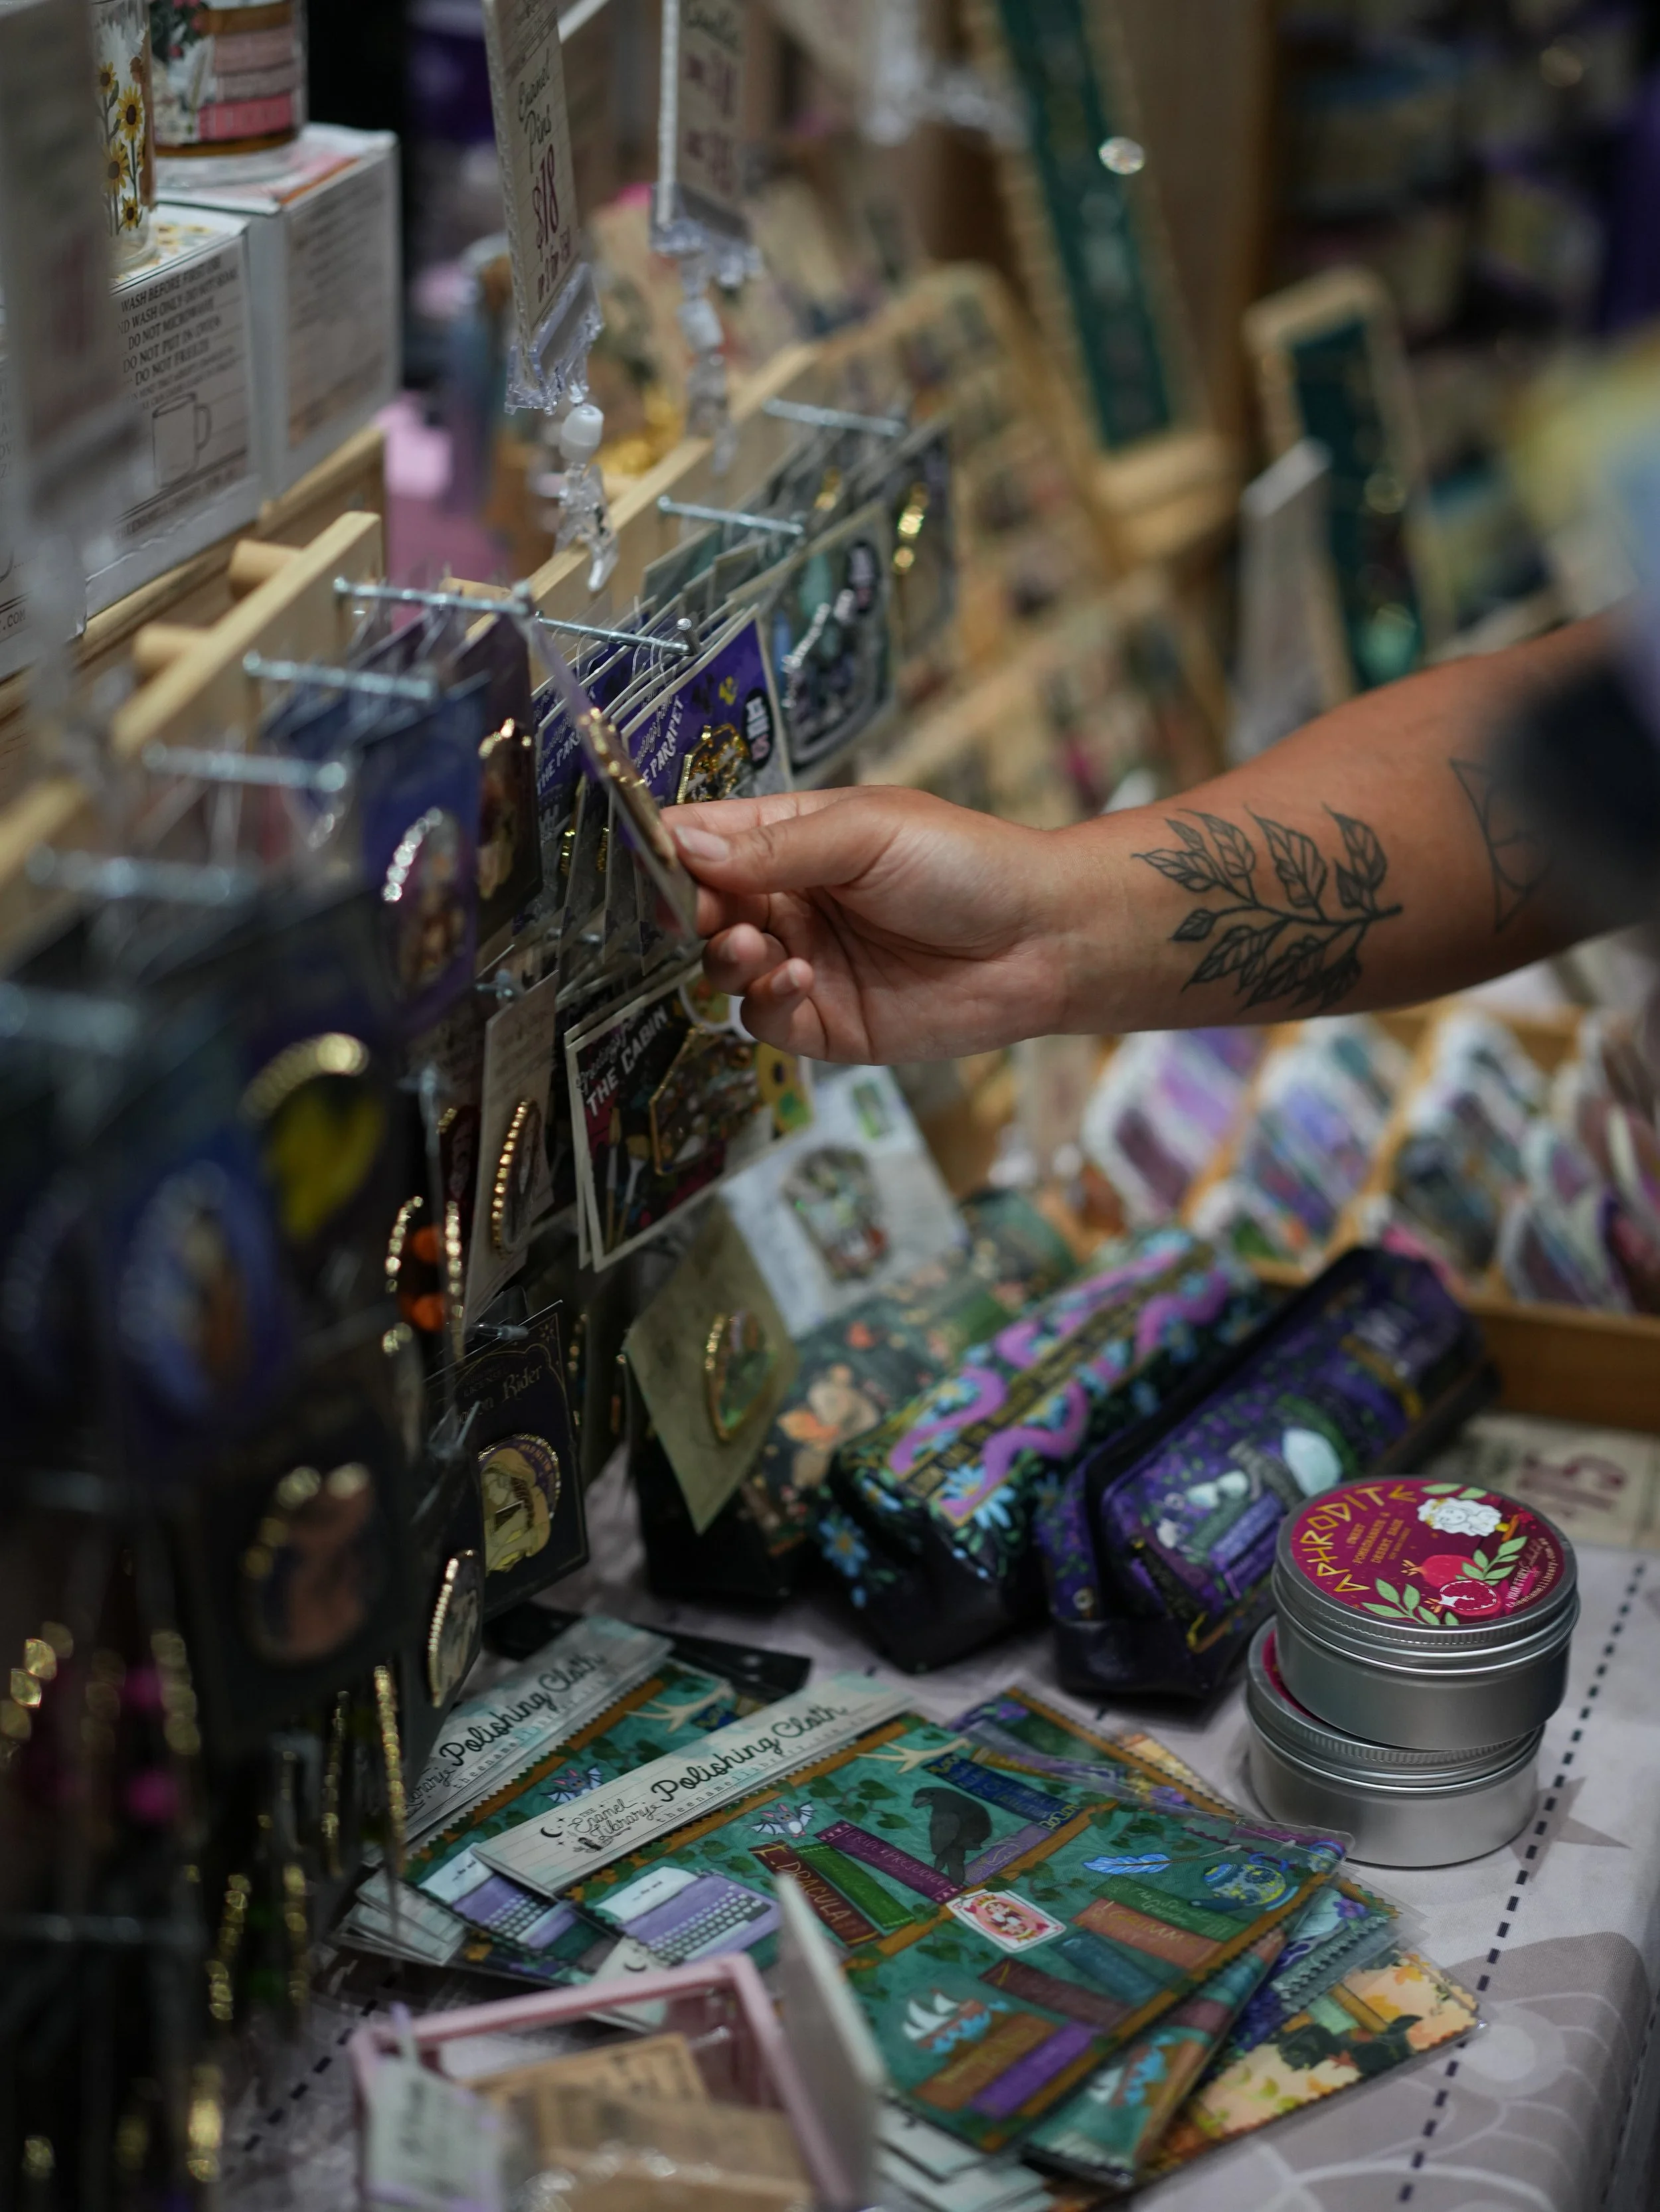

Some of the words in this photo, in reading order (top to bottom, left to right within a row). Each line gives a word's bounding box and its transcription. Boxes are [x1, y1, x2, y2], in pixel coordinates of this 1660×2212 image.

[533, 143, 558, 262] $18
[121, 291, 147, 312] WASH
[147, 275, 181, 301] BEFORE
[131, 305, 157, 329] WASH
[129, 333, 141, 351] DO
[142, 322, 161, 343] NOT
[123, 356, 137, 373] DO
[139, 343, 159, 363] NOT
[135, 368, 149, 386] DO
[151, 356, 171, 375] NOT
[649, 694, 684, 778] PARAPET
[586, 1066, 620, 1118] THE
[620, 1004, 669, 1075] CABIN
[501, 1364, 543, 1402] Rider
[439, 1691, 560, 1767] Polishing
[538, 1654, 608, 1692] Cloth
[650, 1733, 782, 1802] Polishing
[772, 1703, 849, 1739] Cloth
[567, 1798, 639, 1834] Enamel
[777, 1861, 852, 1923] DRACULA
